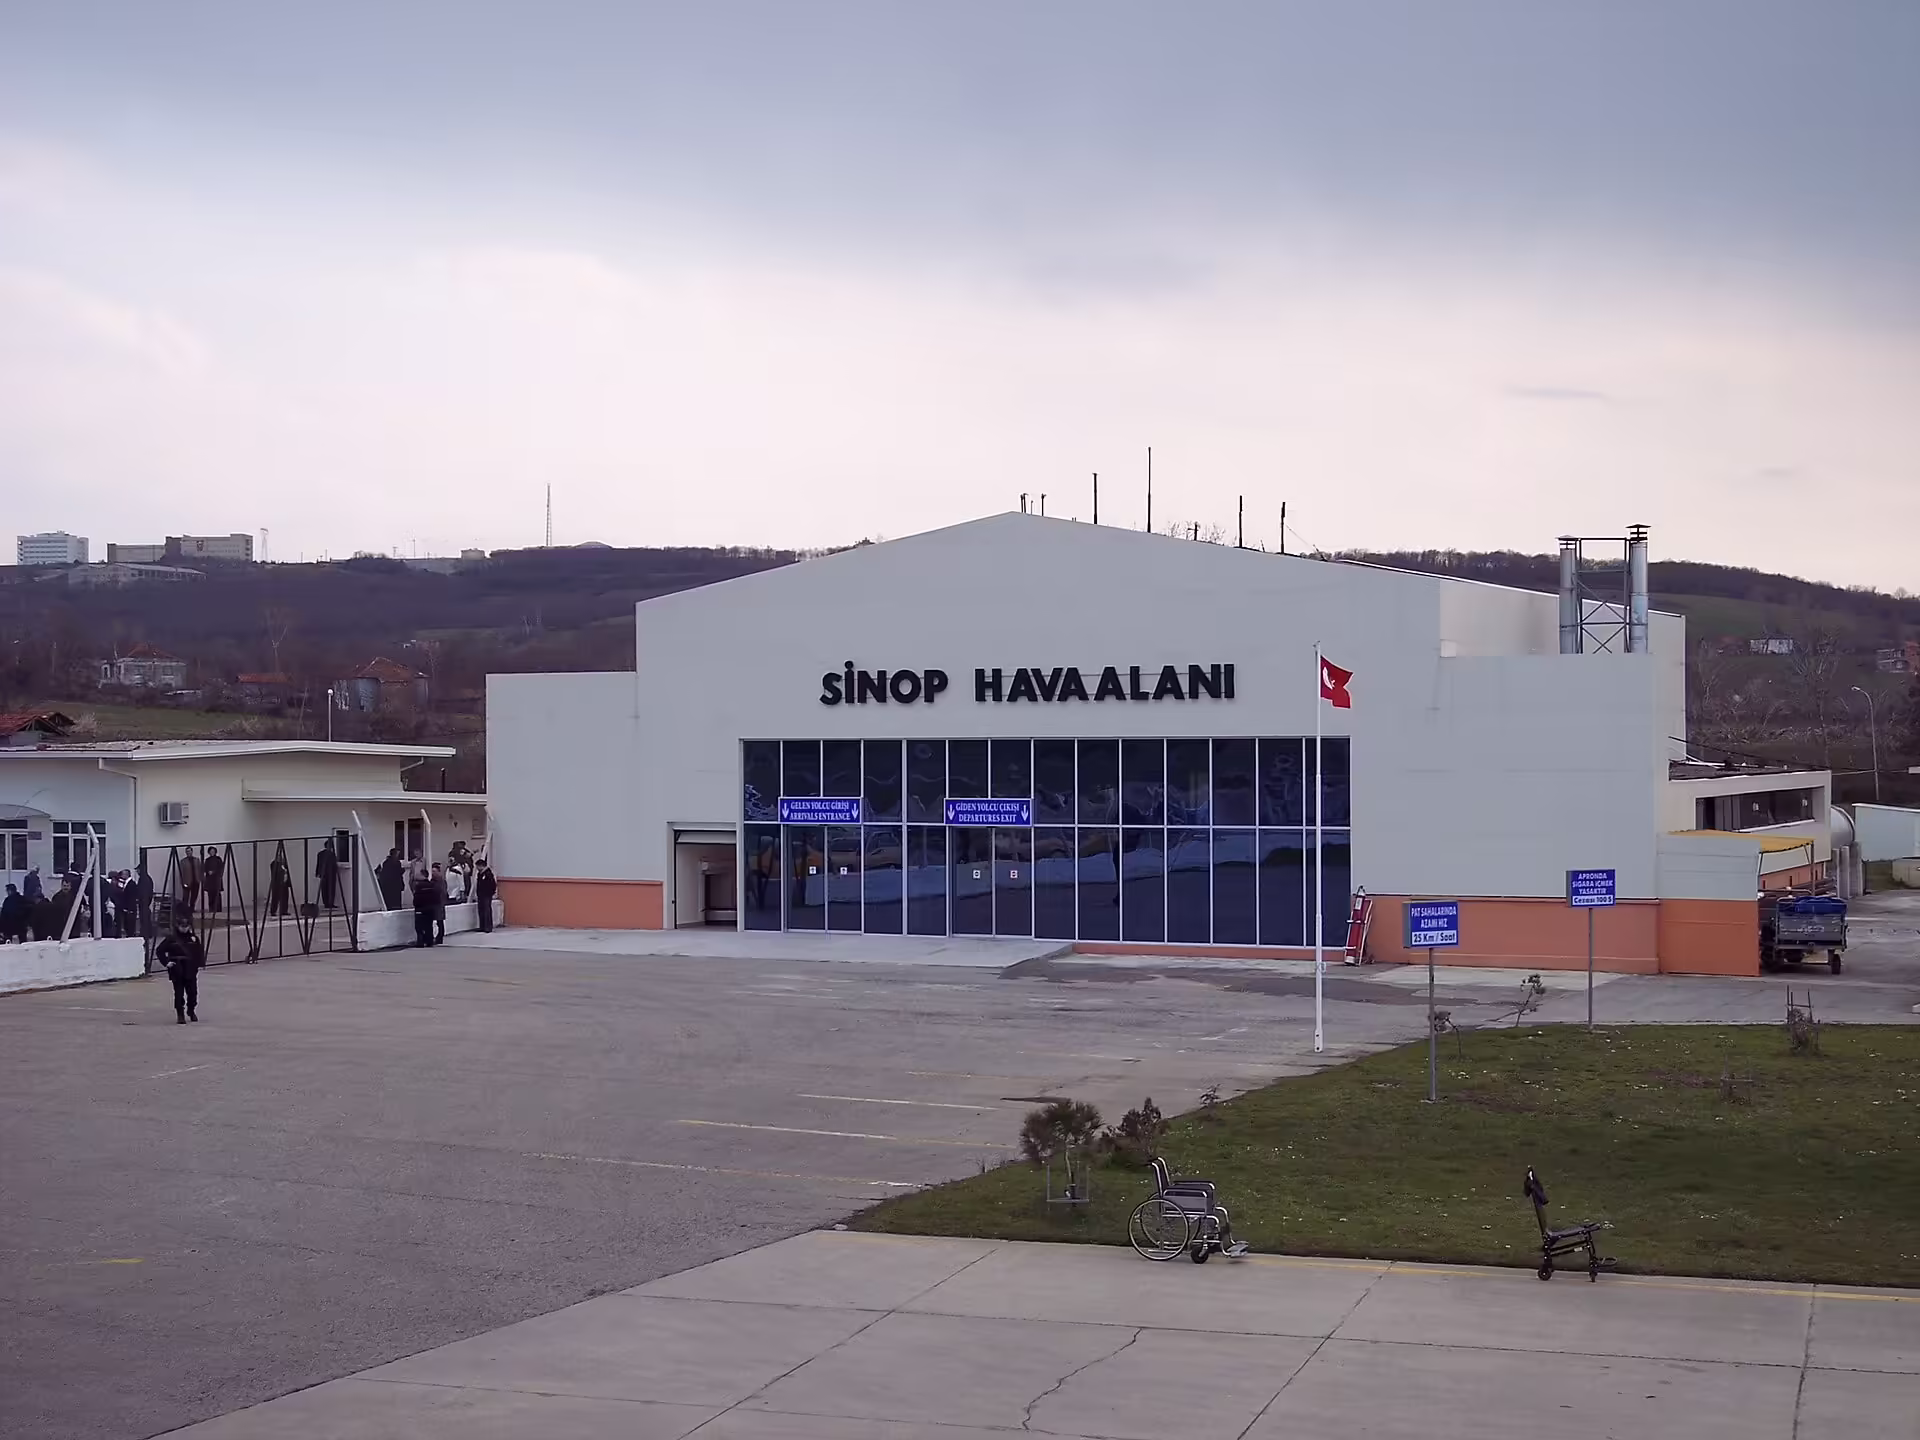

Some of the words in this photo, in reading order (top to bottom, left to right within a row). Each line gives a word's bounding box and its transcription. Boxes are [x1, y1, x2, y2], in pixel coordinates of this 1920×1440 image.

[819, 660, 949, 704] SİNOP
[974, 664, 1236, 702] HAVAALANI
[790, 801, 810, 810] GELEN
[811, 801, 830, 810] YOLCU
[955, 801, 976, 811] GİDEN
[977, 802, 998, 811] YOLCU
[790, 812, 818, 821] ARRIVALS
[819, 812, 851, 821] ENTRANCE
[958, 813, 1000, 822] DEPARTURES
[1000, 814, 1017, 822] EXIT
[1578, 872, 1607, 880] APRONDA
[1411, 907, 1420, 917] PAT
[1413, 933, 1422, 943] 25
[1423, 933, 1435, 943] Km
[1440, 932, 1455, 942] Saat
